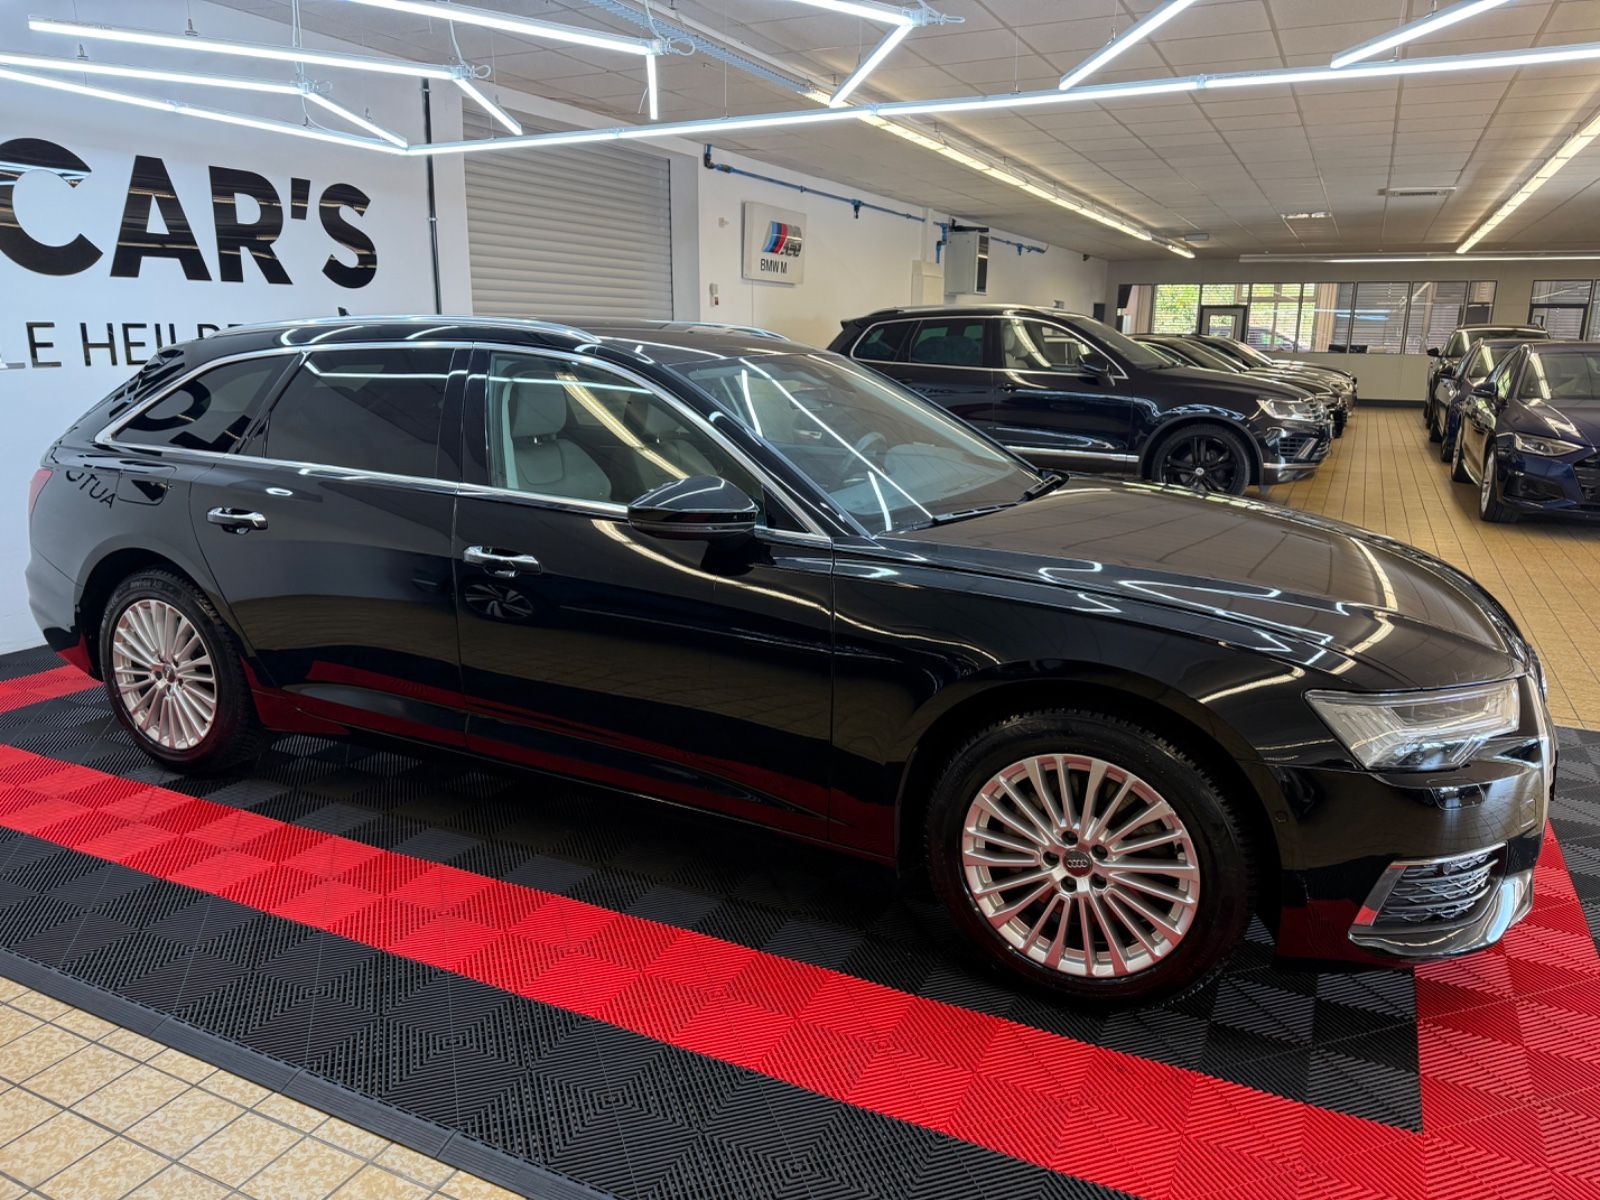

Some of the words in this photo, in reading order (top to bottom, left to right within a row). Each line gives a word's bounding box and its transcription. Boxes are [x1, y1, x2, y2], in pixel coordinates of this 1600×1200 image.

[0, 137, 378, 289] CAR'S
[760, 258, 779, 273] BMW
[780, 260, 787, 273] M
